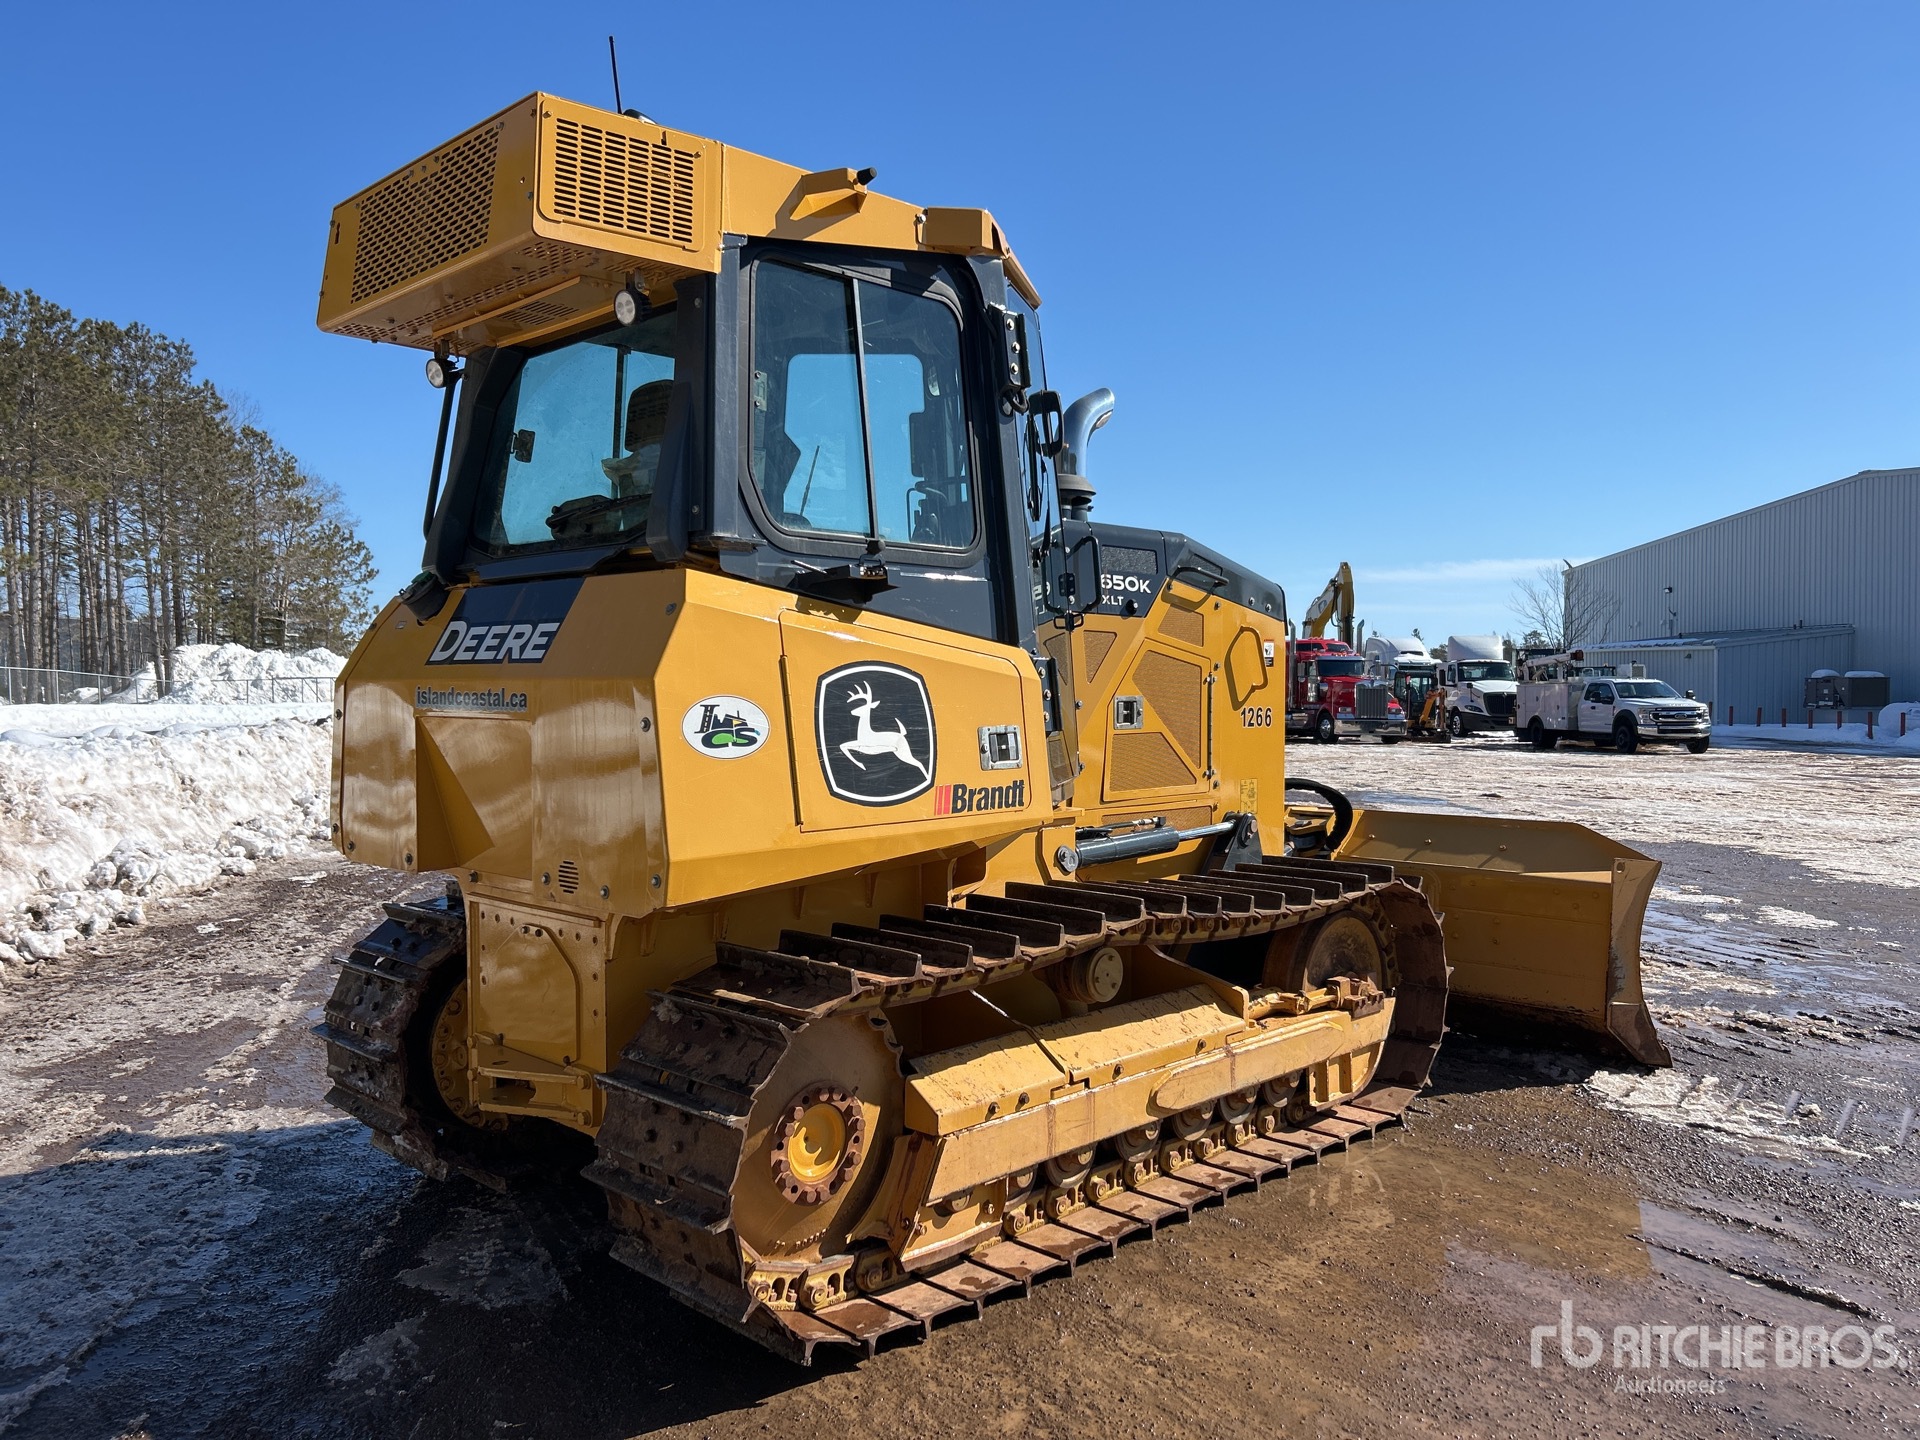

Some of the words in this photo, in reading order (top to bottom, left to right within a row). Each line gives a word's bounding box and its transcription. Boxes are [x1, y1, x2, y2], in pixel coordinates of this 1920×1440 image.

[1101, 574, 1151, 594] 650K
[1101, 594, 1124, 606] XLT
[429, 621, 560, 661] DEERE
[416, 686, 527, 708] islandcoastal.ca
[1240, 706, 1272, 728] 1266
[951, 780, 1025, 814] Brandt
